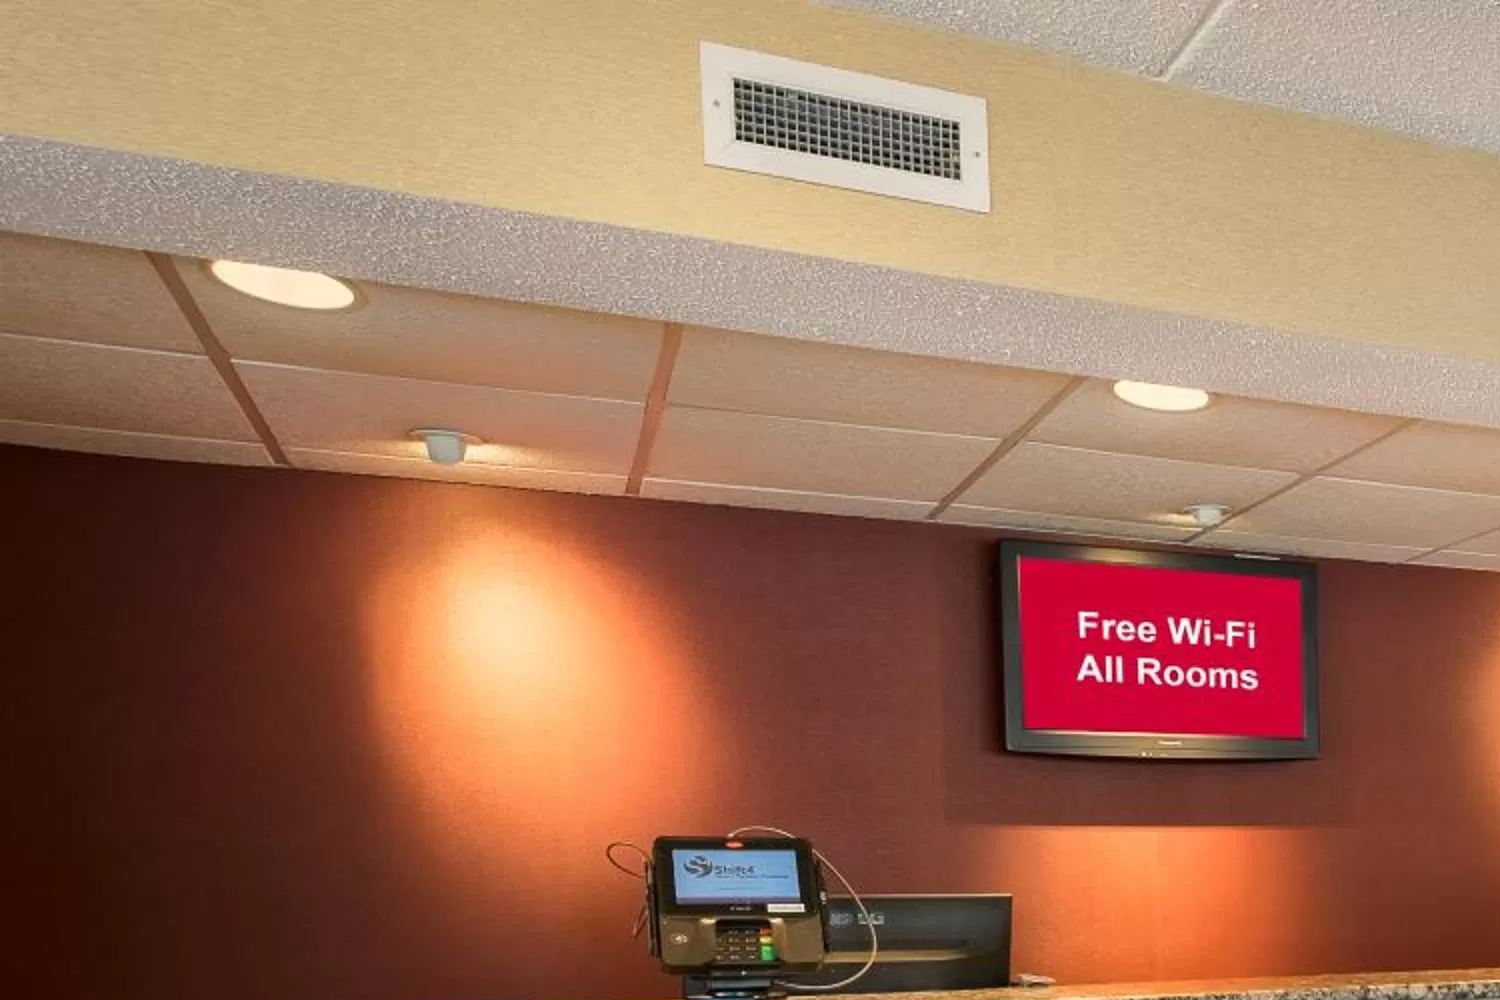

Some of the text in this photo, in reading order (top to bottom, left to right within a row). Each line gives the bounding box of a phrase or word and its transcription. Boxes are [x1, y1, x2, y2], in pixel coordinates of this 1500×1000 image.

[1077, 611, 1256, 649] Free Wi-Fi
[1076, 654, 1260, 691] All Rooms
